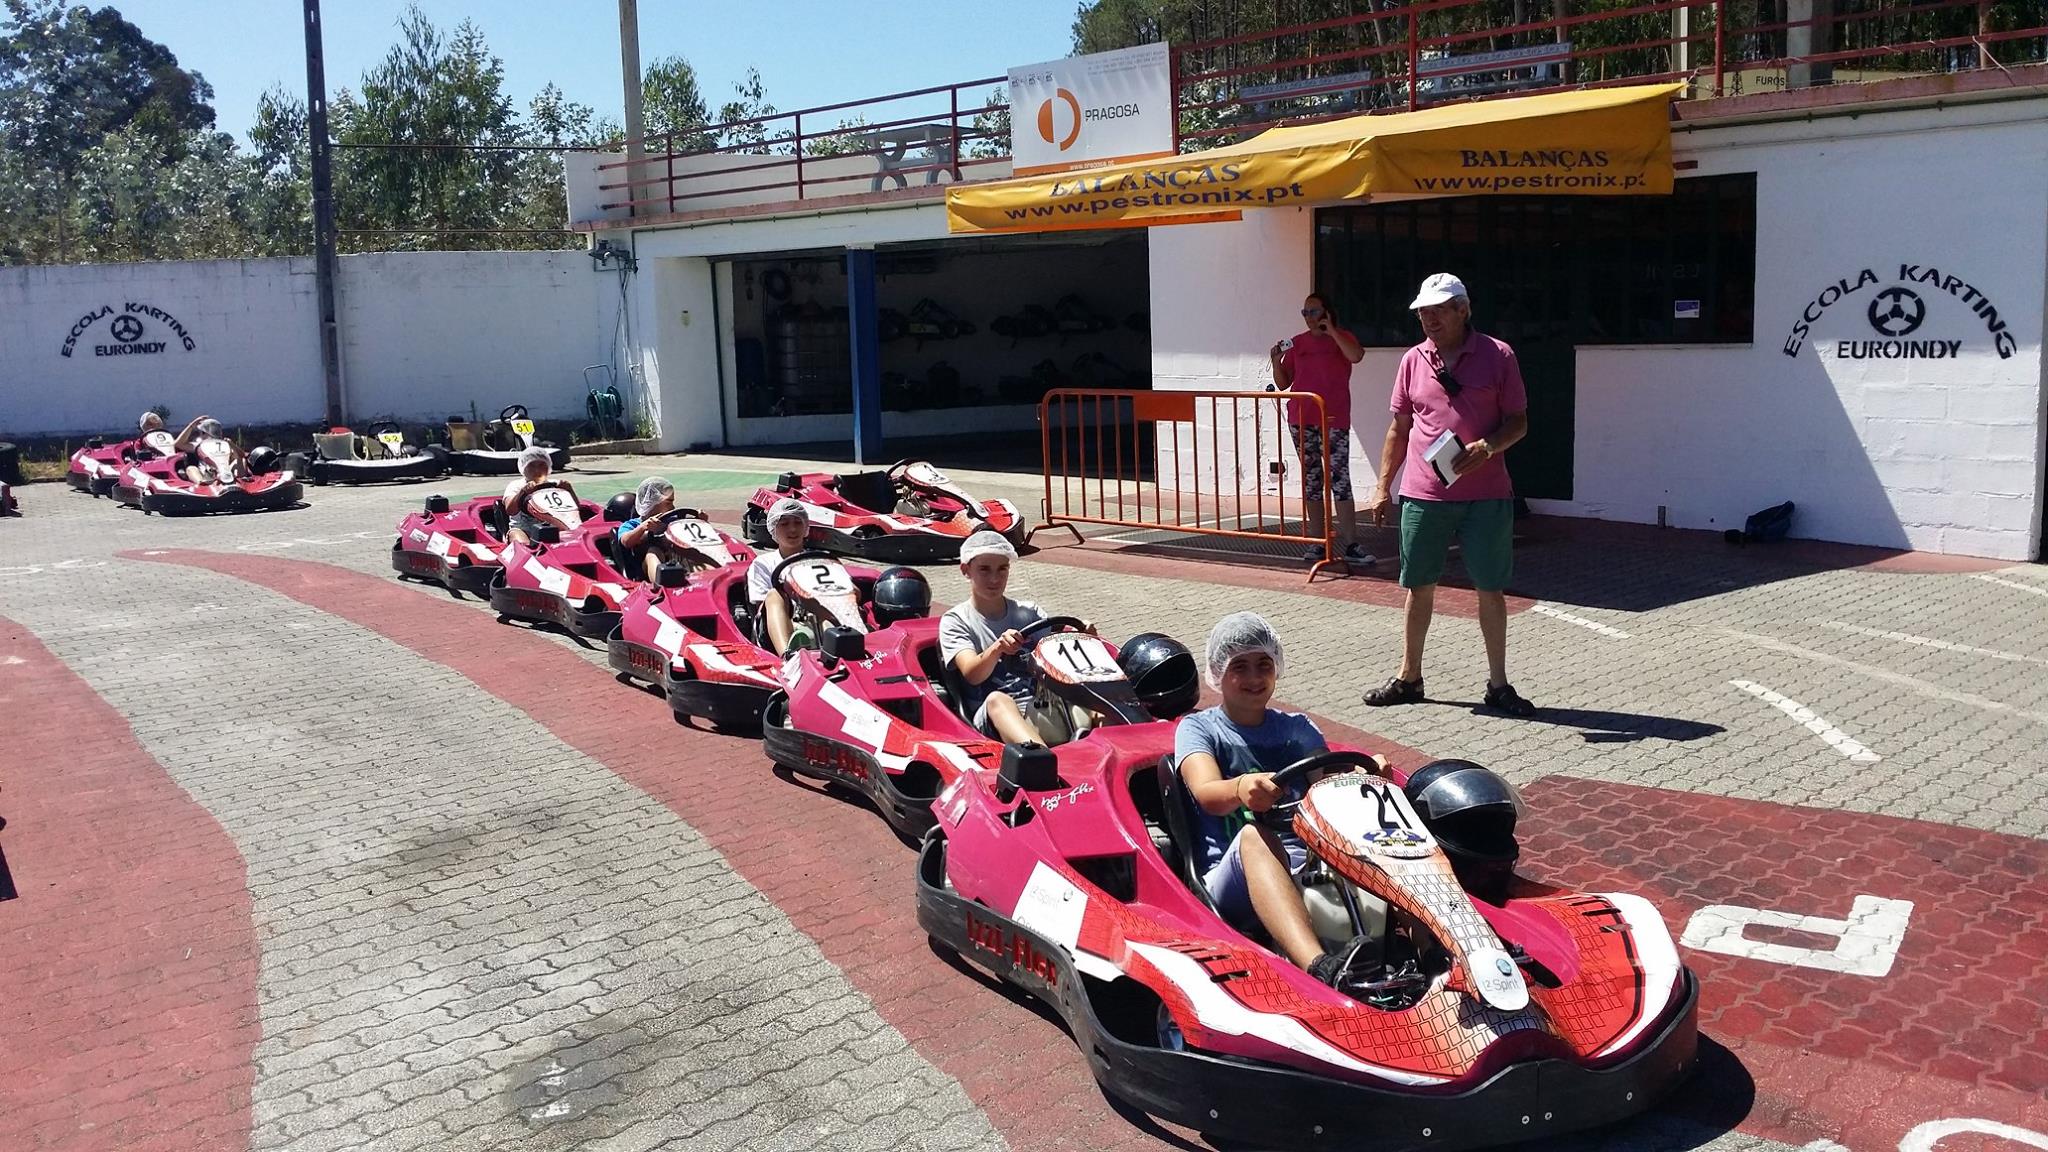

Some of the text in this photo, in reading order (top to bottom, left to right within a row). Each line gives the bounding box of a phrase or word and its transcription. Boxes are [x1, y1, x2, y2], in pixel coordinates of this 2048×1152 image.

[1756, 75, 1785, 86] FUROS
[1085, 103, 1140, 123] PRAGOSA
[1460, 150, 1609, 172] BALANÇAS
[1004, 181, 1305, 221] www.pestronix.pt
[1783, 263, 2017, 360] ESCOLA KARTING
[61, 302, 196, 358] ESCOLA KARTING
[95, 342, 166, 356] EUROINDY
[1837, 340, 1962, 359] EUROINDY
[544, 491, 563, 506] 16
[684, 522, 708, 540] 12
[811, 565, 835, 584] 2
[1058, 639, 1095, 670] 11
[1359, 783, 1413, 830] 21
